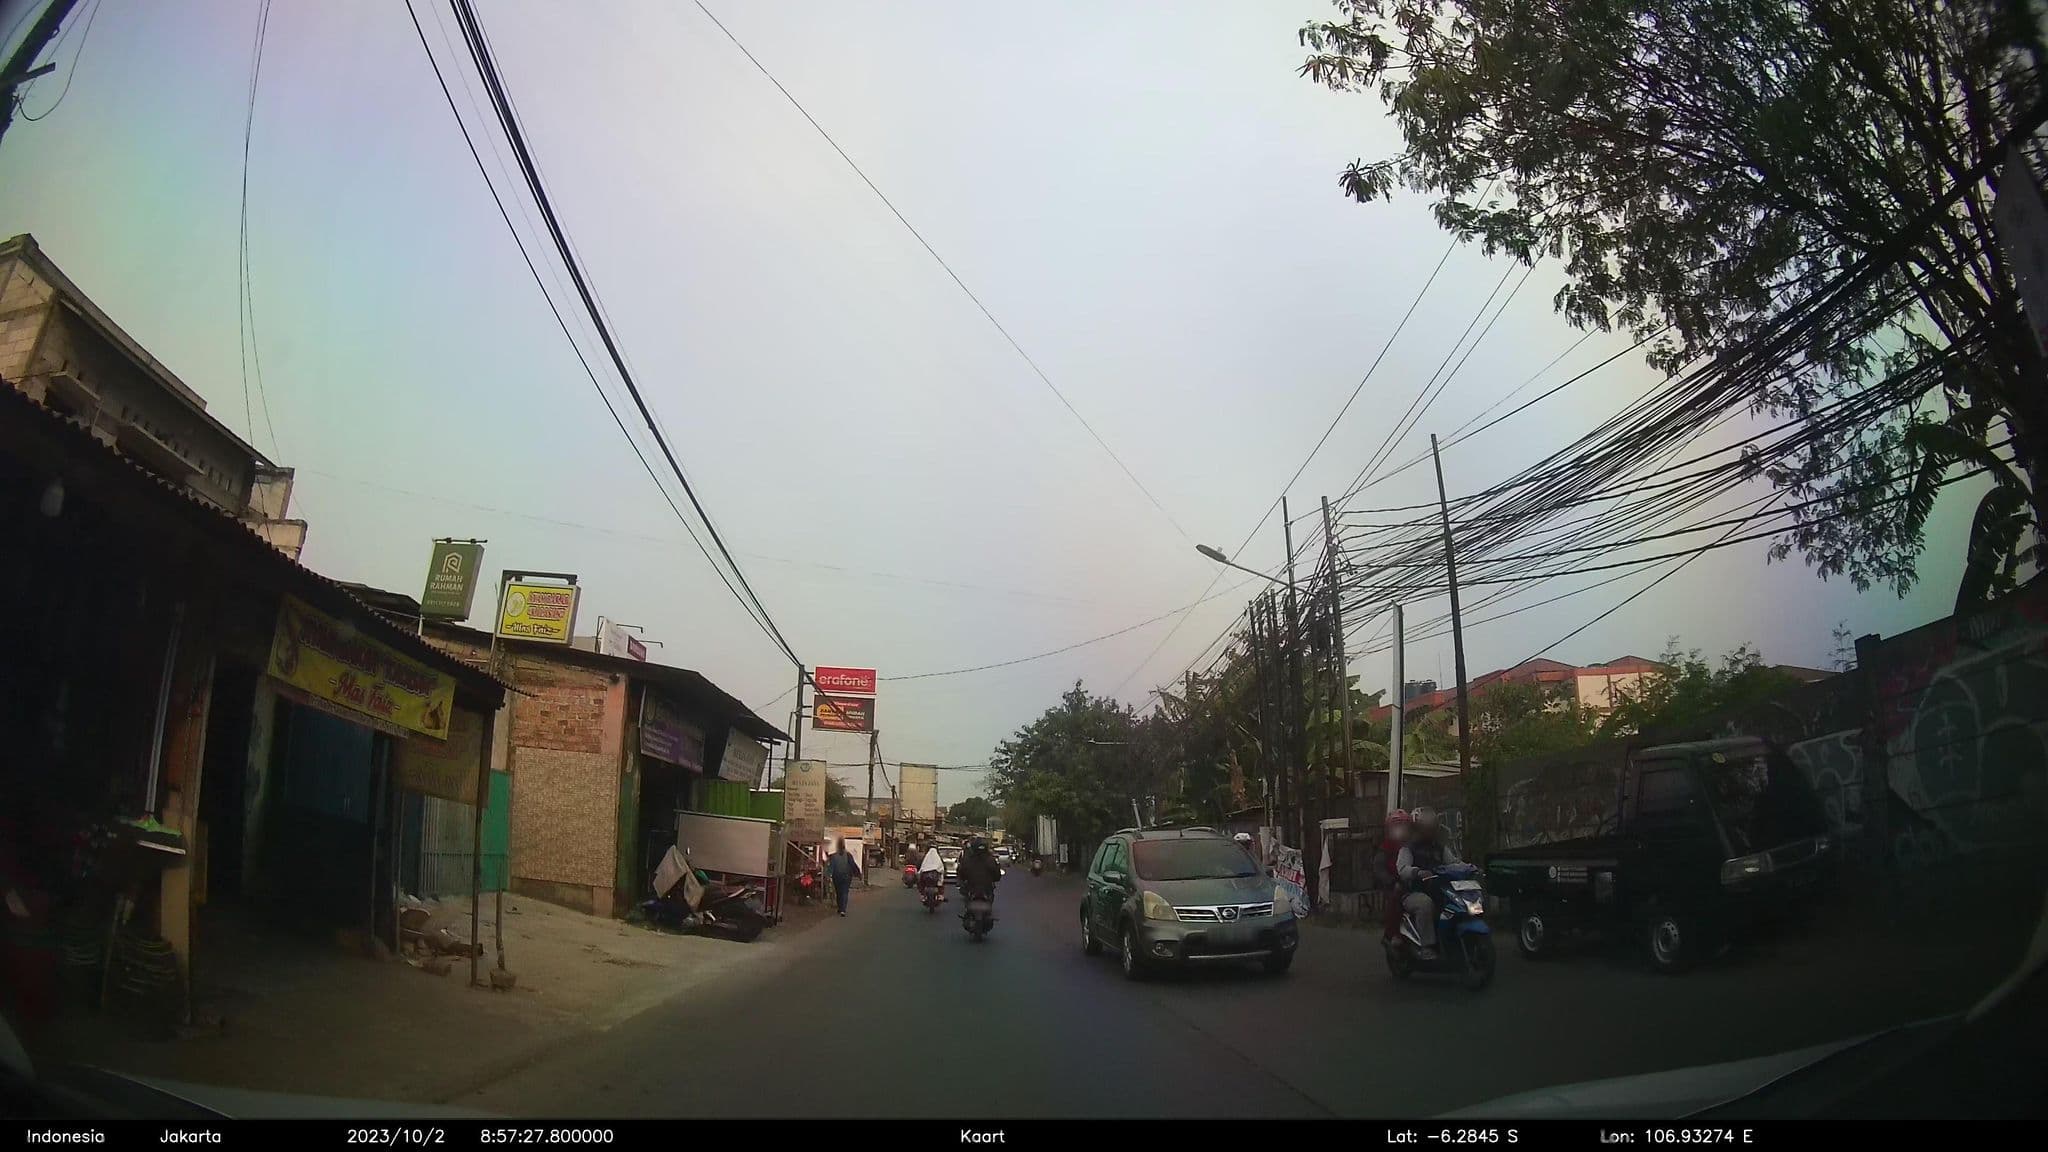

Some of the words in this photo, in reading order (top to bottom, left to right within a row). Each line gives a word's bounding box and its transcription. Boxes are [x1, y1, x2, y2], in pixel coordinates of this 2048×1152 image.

[434, 574, 464, 583] RUMAH
[431, 582, 465, 591] RAHMAN
[818, 674, 869, 687] erafone
